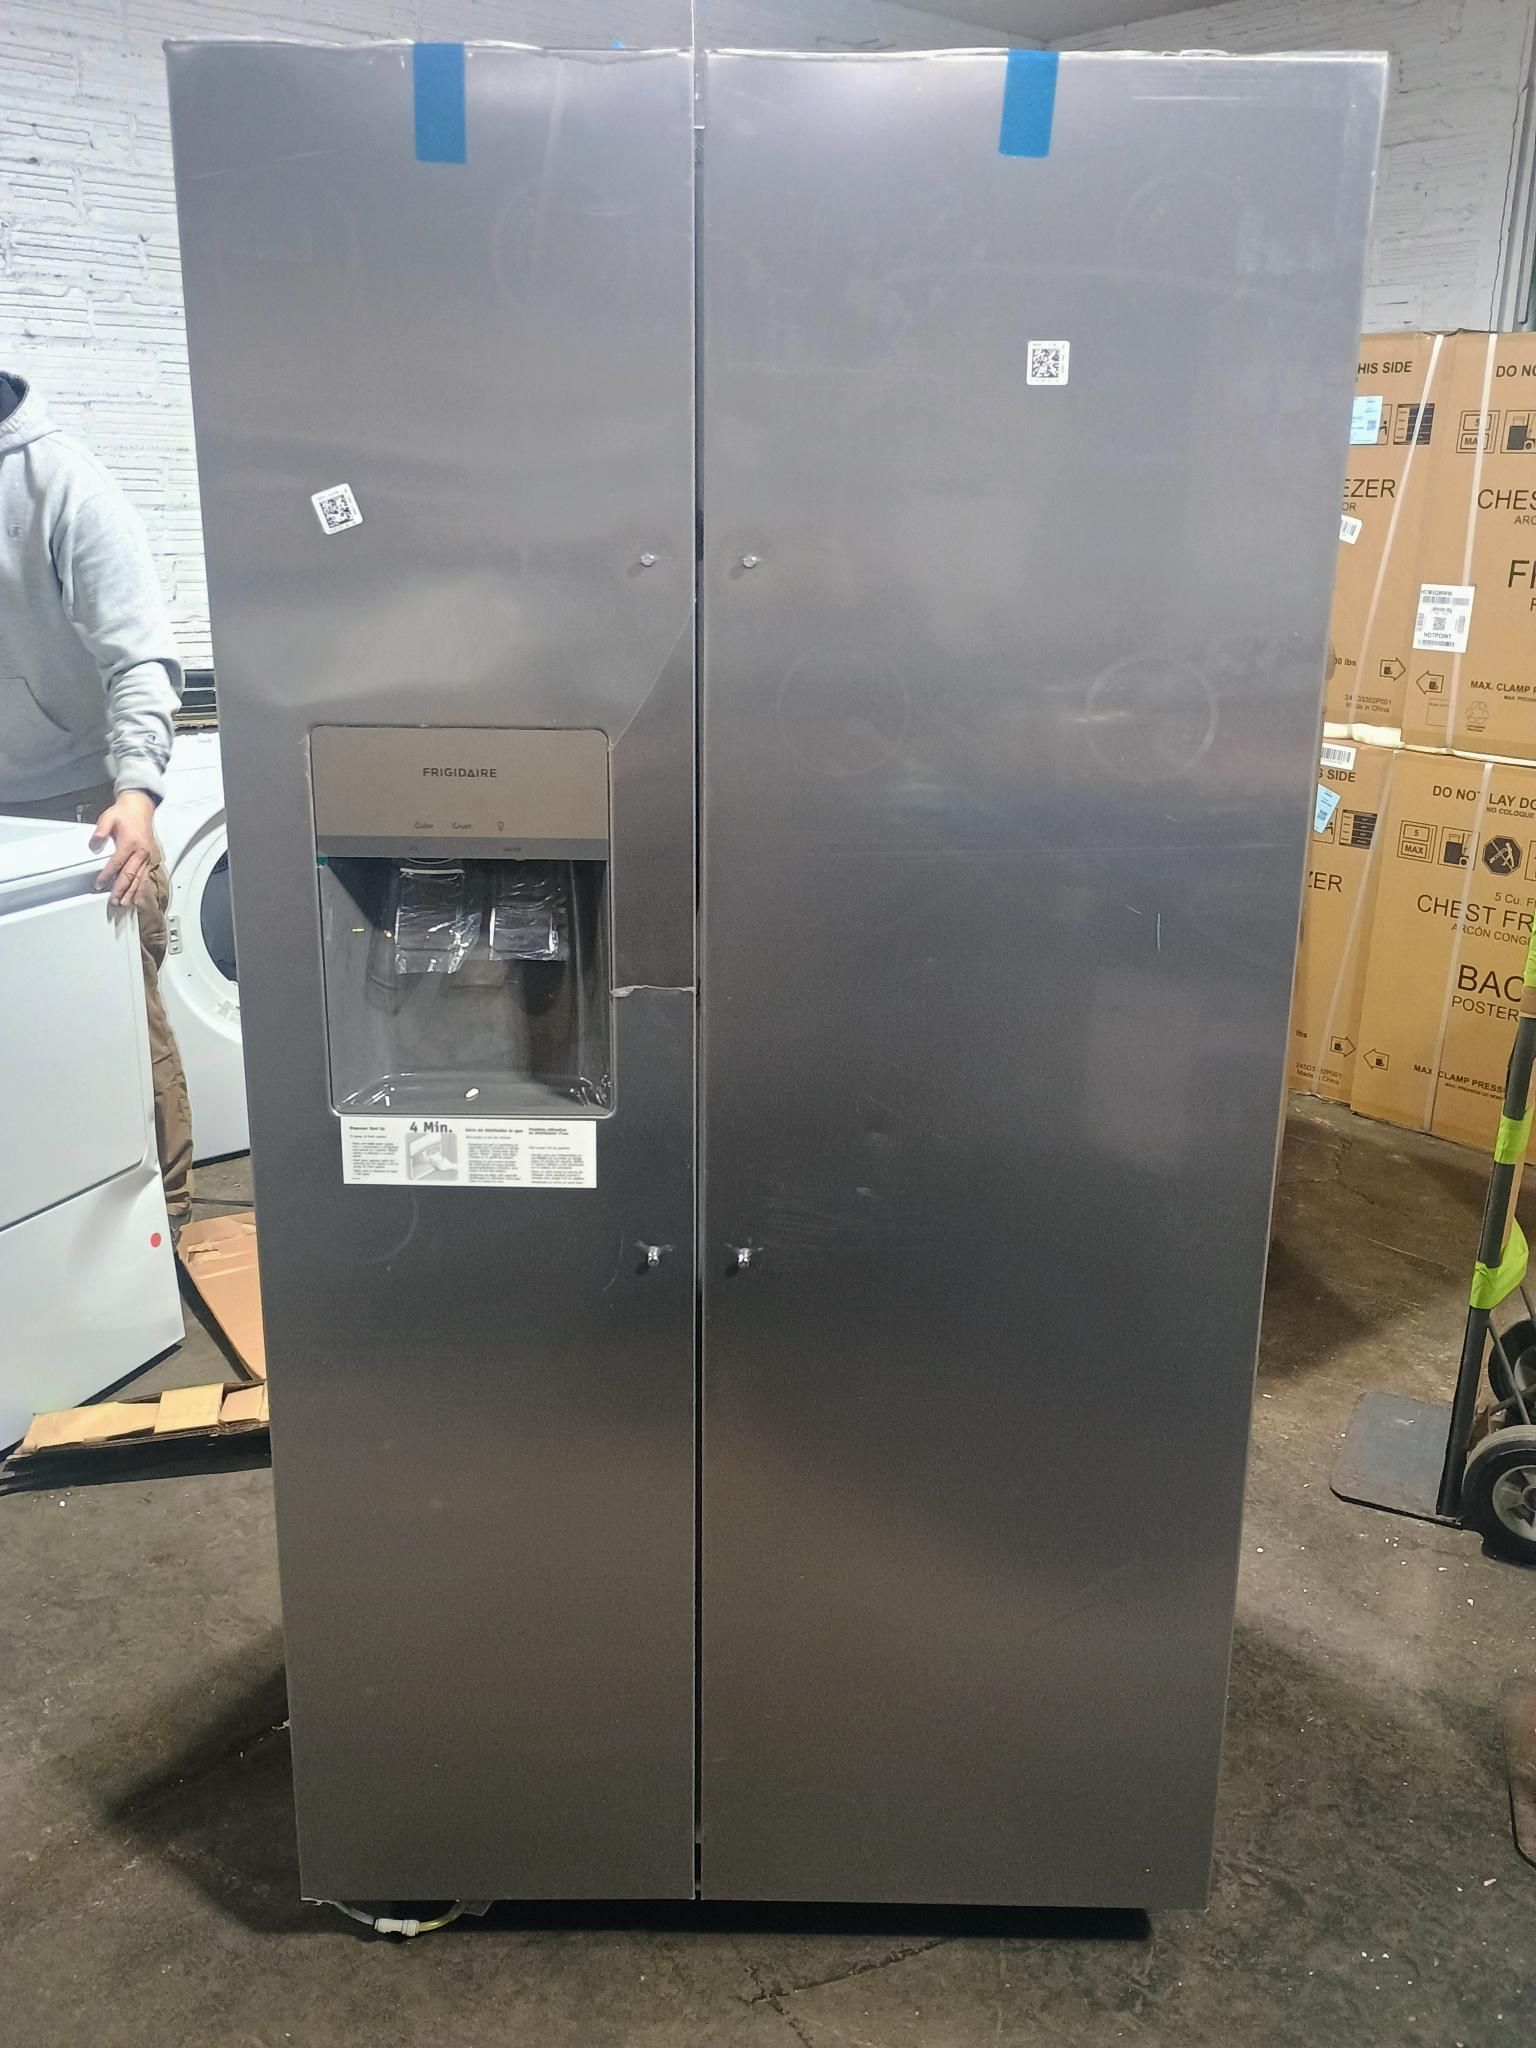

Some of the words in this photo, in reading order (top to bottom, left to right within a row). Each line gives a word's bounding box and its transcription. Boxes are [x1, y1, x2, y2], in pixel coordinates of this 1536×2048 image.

[1382, 361, 1413, 374] SIDE
[1496, 365, 1517, 378] DO
[1496, 682, 1531, 693] CLAMP
[423, 767, 497, 778] FRIGIDAIRE
[1327, 769, 1356, 783] SIDE
[1432, 785, 1453, 798] DO
[1488, 793, 1516, 807] LAY
[1414, 829, 1420, 837] 5
[1404, 844, 1424, 855] MAX
[1494, 892, 1502, 901] 5
[1417, 894, 1497, 924] CHEST
[1493, 930, 1530, 946] CONG
[1451, 995, 1520, 1022] POSTER
[1437, 1070, 1470, 1084] CLAMP
[1471, 1079, 1504, 1094] PRESS
[409, 1121, 418, 1133] 4
[423, 1120, 453, 1134] Min.
